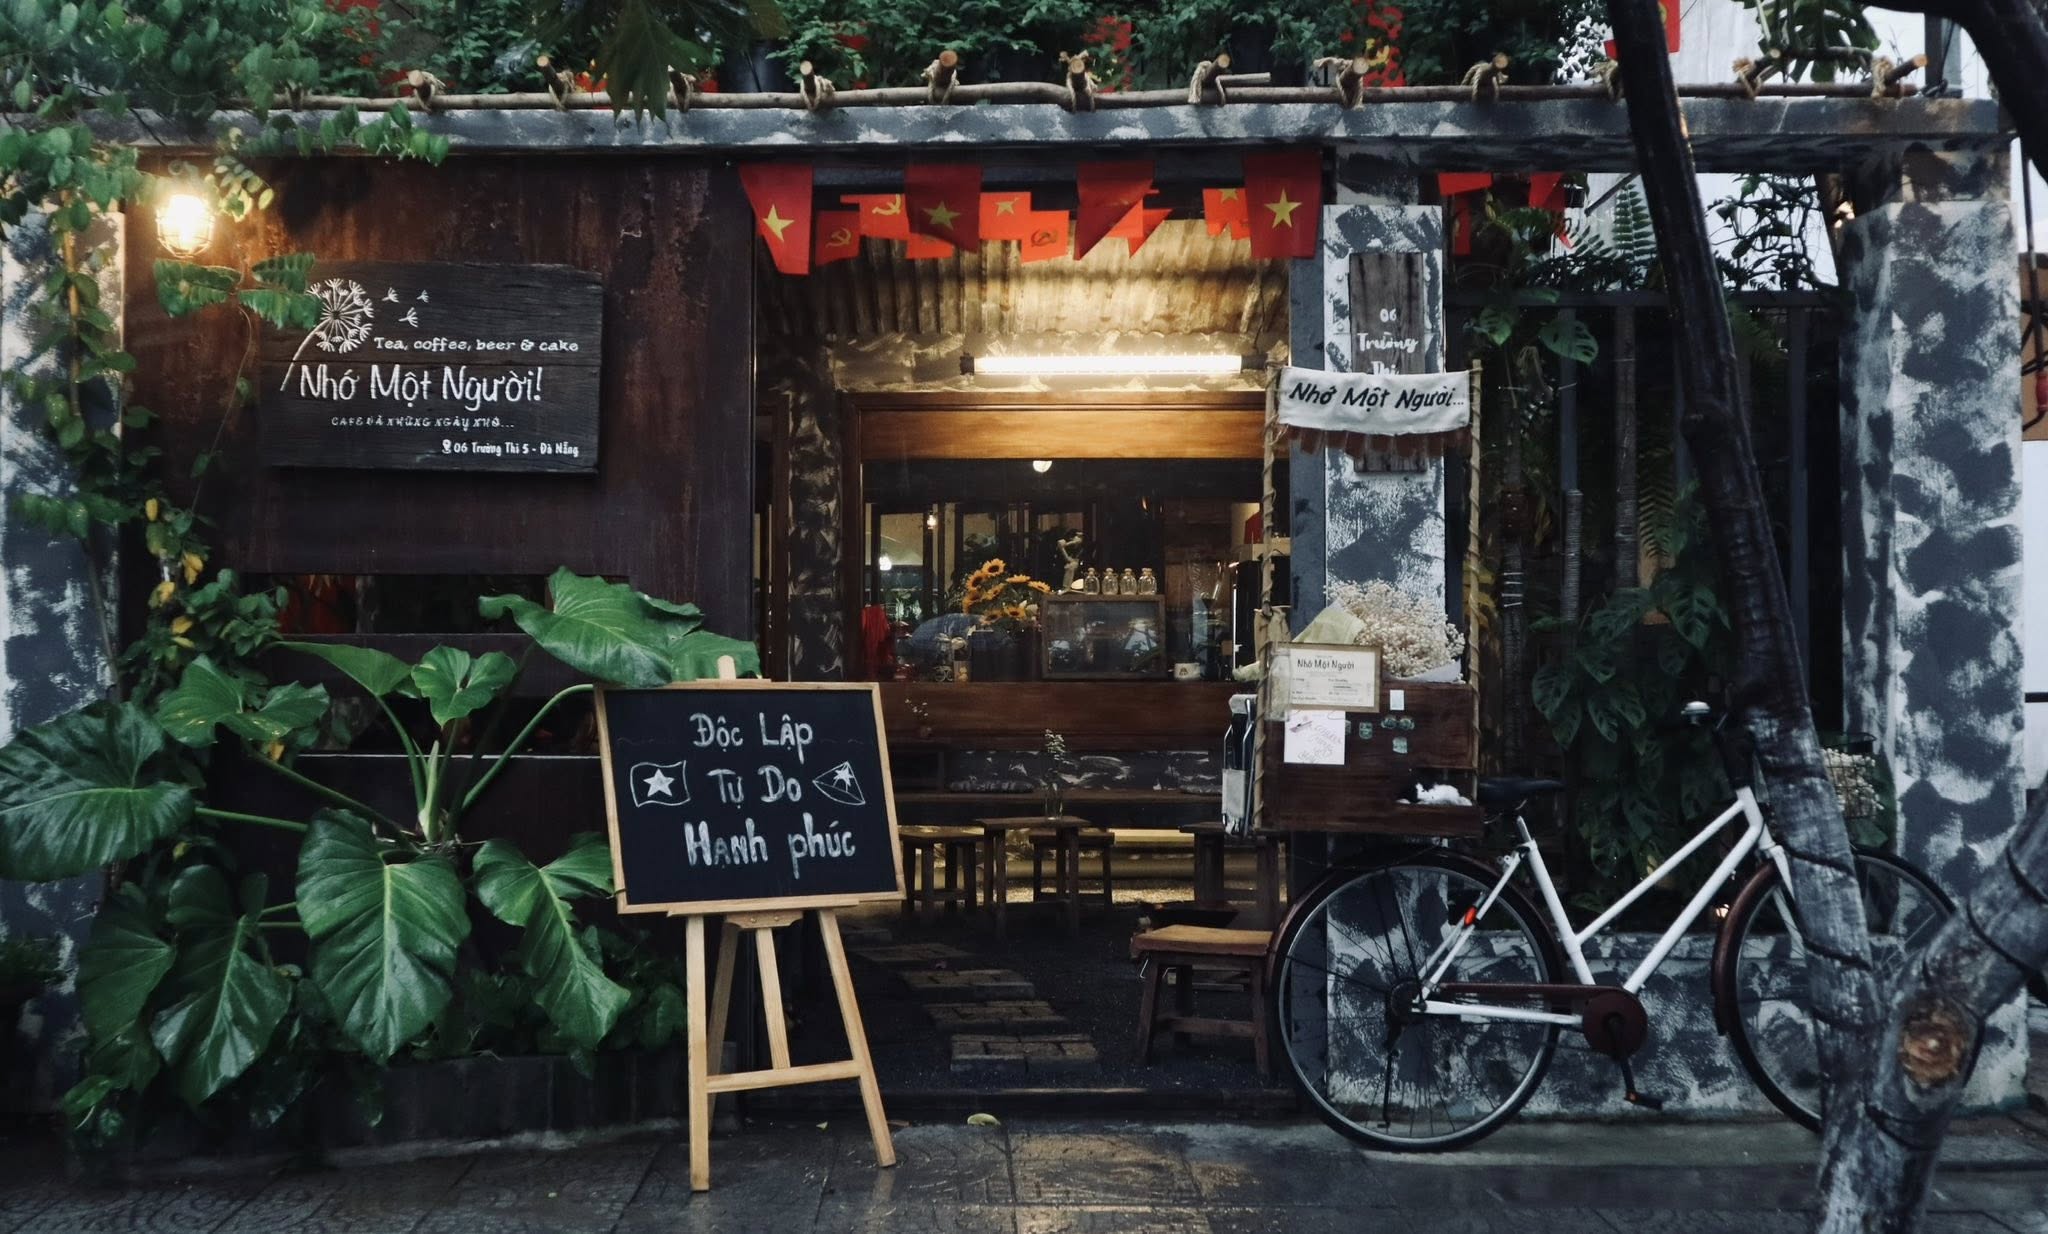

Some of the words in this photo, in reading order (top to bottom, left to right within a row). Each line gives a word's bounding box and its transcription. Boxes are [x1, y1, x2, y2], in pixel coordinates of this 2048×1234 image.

[1380, 309, 1397, 322] 06
[374, 337, 408, 351] Tea,
[413, 337, 472, 352] coffee,
[476, 339, 515, 351] beer
[520, 339, 534, 351] &
[539, 340, 579, 352] cake
[300, 364, 360, 400] Nhớ
[370, 364, 431, 408] Một
[442, 366, 543, 411] Người!
[1341, 387, 1391, 412] Một
[453, 442, 468, 454] 06
[540, 442, 553, 455] Đà
[555, 441, 579, 458] Nẵng
[689, 713, 744, 753] Độc
[758, 712, 813, 765] Lập
[757, 764, 802, 803] Do
[787, 812, 856, 879] phúc
